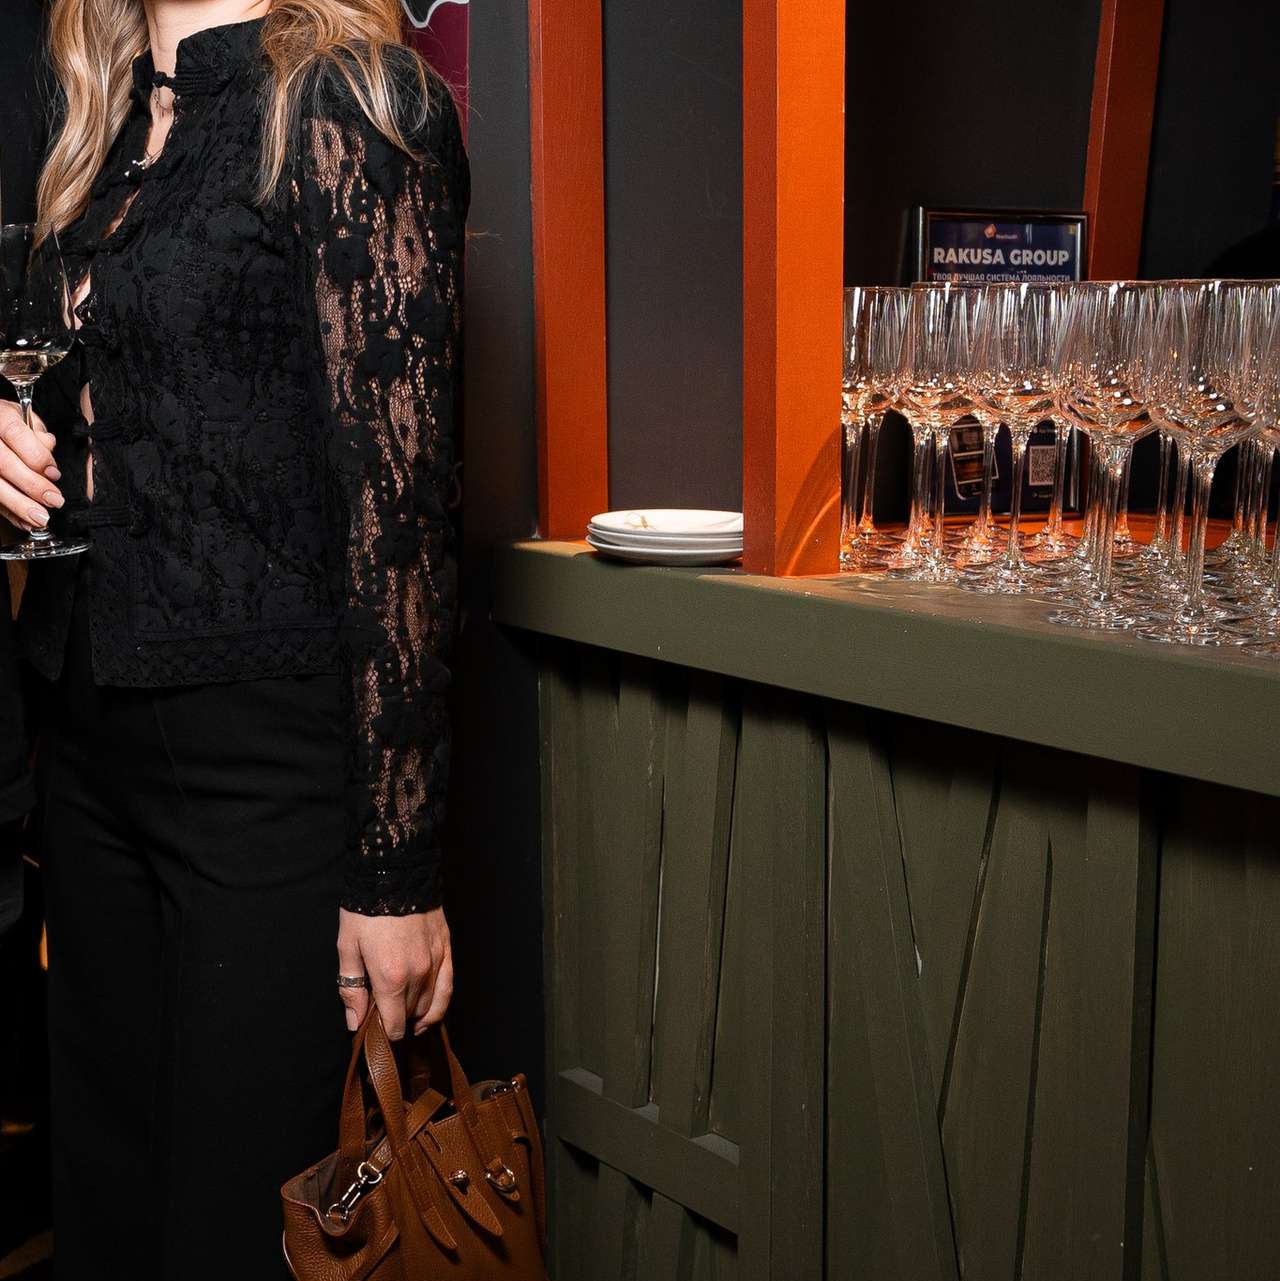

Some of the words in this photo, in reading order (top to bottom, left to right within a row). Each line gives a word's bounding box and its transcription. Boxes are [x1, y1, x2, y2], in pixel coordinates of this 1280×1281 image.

[933, 247, 1005, 265] RAKUSA
[1009, 249, 1070, 266] GROUP
[932, 272, 952, 281] ТВОЯ
[954, 273, 984, 282] ЛУЧШАЯ
[986, 273, 1020, 282] СИСТЕМА
[1022, 274, 1071, 282] ЛОЯЛЬНОСТИ
